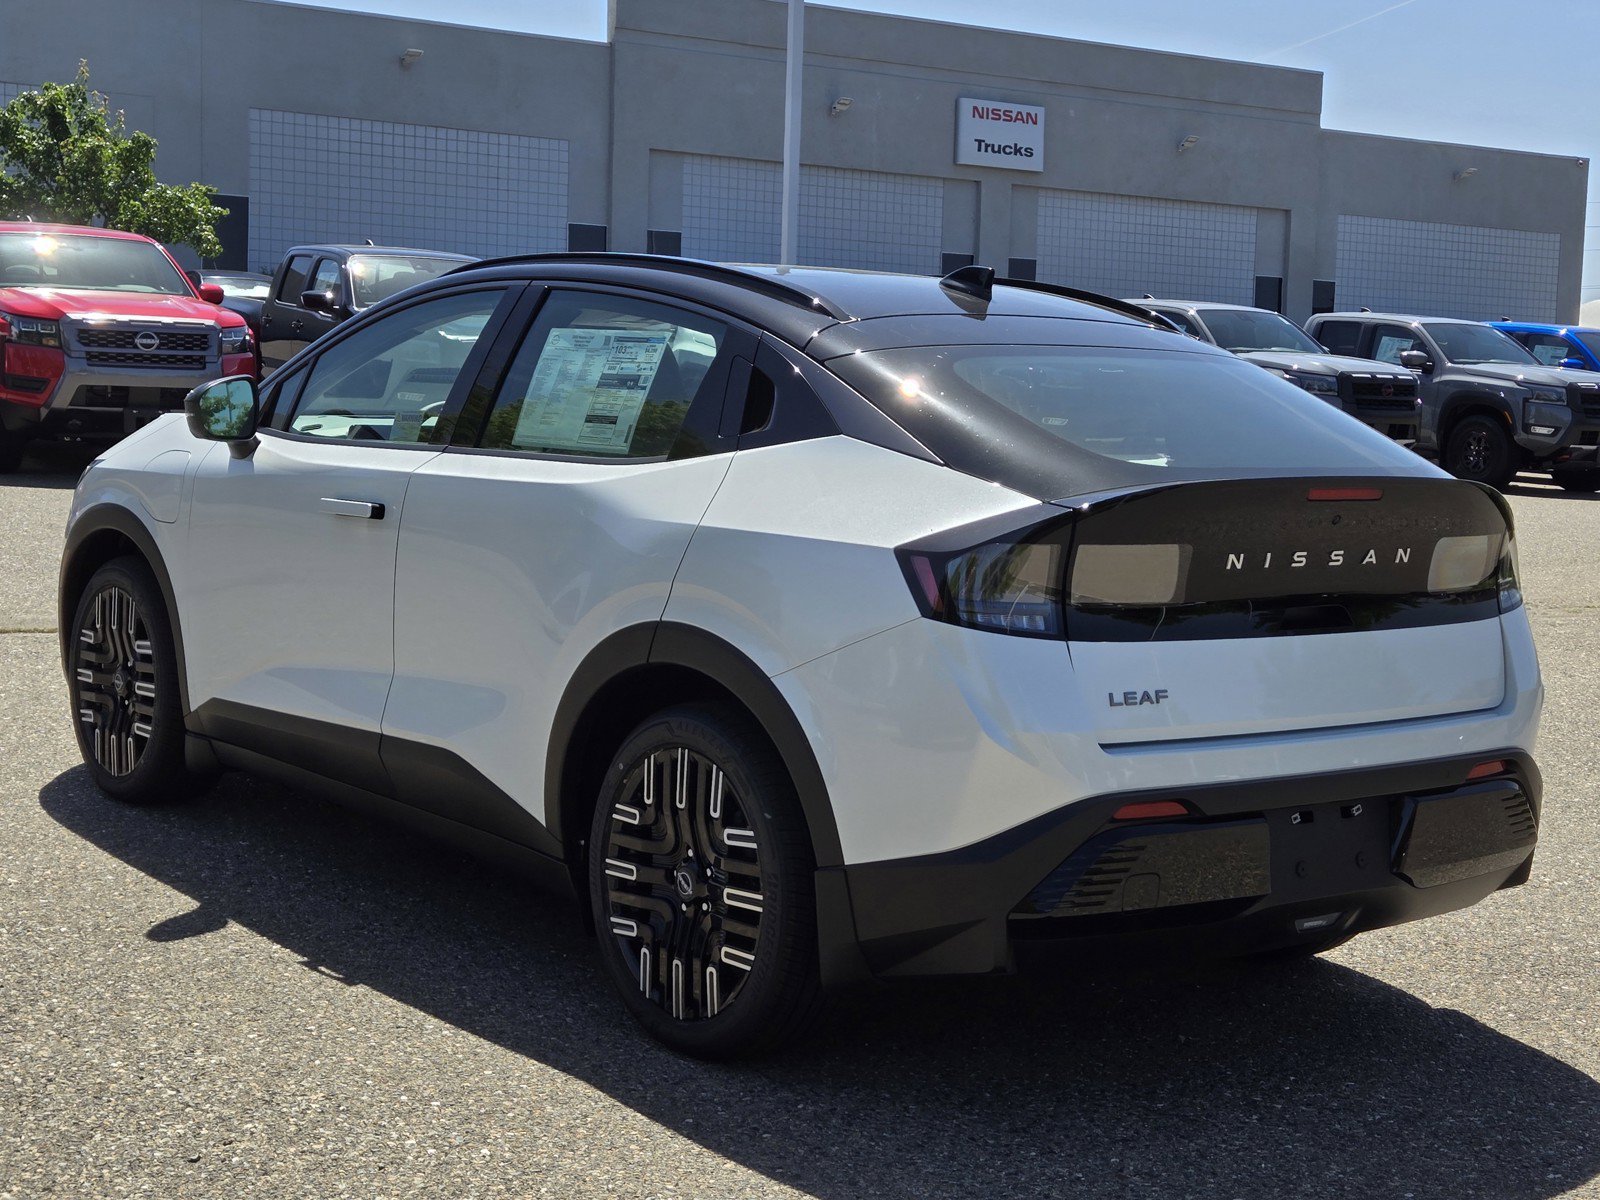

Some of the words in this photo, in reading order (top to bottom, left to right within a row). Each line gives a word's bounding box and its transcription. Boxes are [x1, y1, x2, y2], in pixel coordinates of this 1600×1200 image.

[972, 105, 1038, 125] NISSAN
[974, 138, 1034, 158] Trucks
[1226, 547, 1411, 570] NISSAN
[1108, 689, 1169, 707] LEAF
